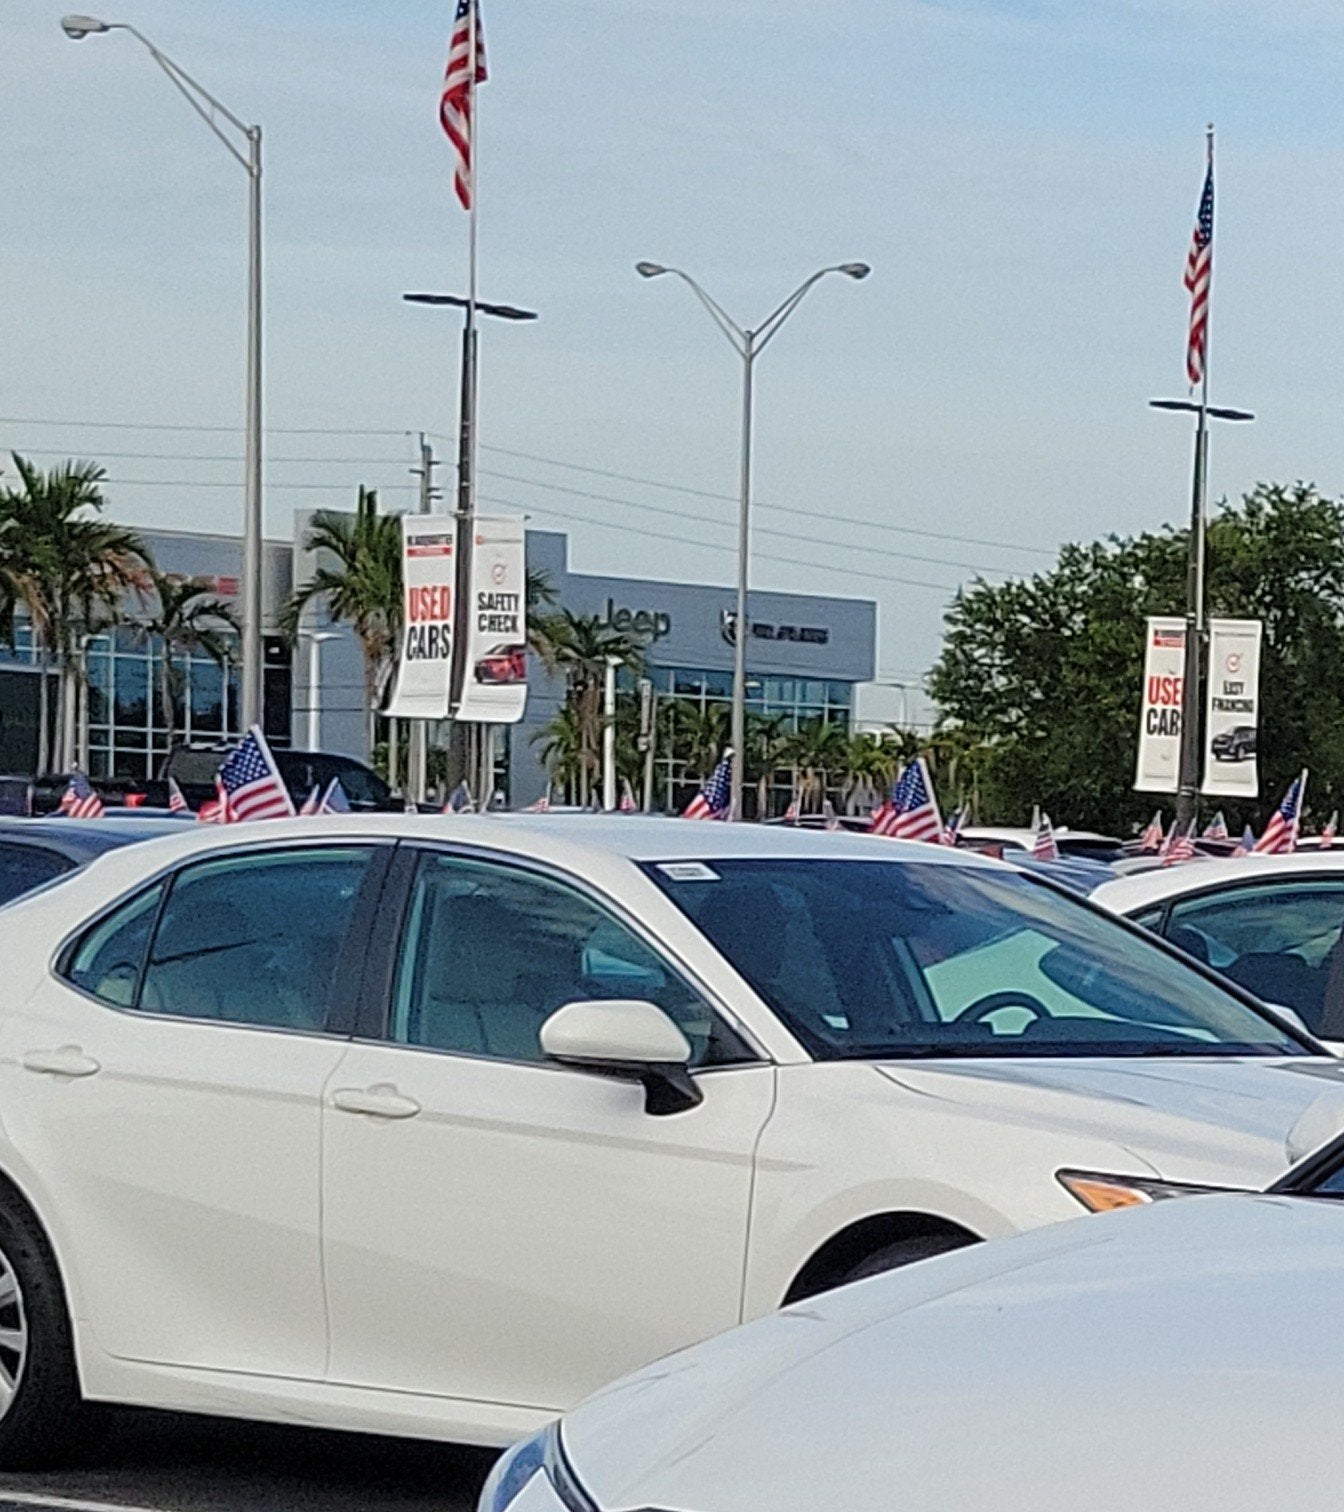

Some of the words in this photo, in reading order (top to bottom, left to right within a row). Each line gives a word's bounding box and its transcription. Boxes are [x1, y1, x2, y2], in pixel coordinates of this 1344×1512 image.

[408, 586, 452, 622] USED
[477, 592, 519, 612] SAFETY
[477, 613, 519, 633] CHECK
[594, 597, 671, 643] Jeep
[406, 623, 452, 661] CARS
[1148, 676, 1183, 706] USE
[1146, 708, 1182, 736] CAR
